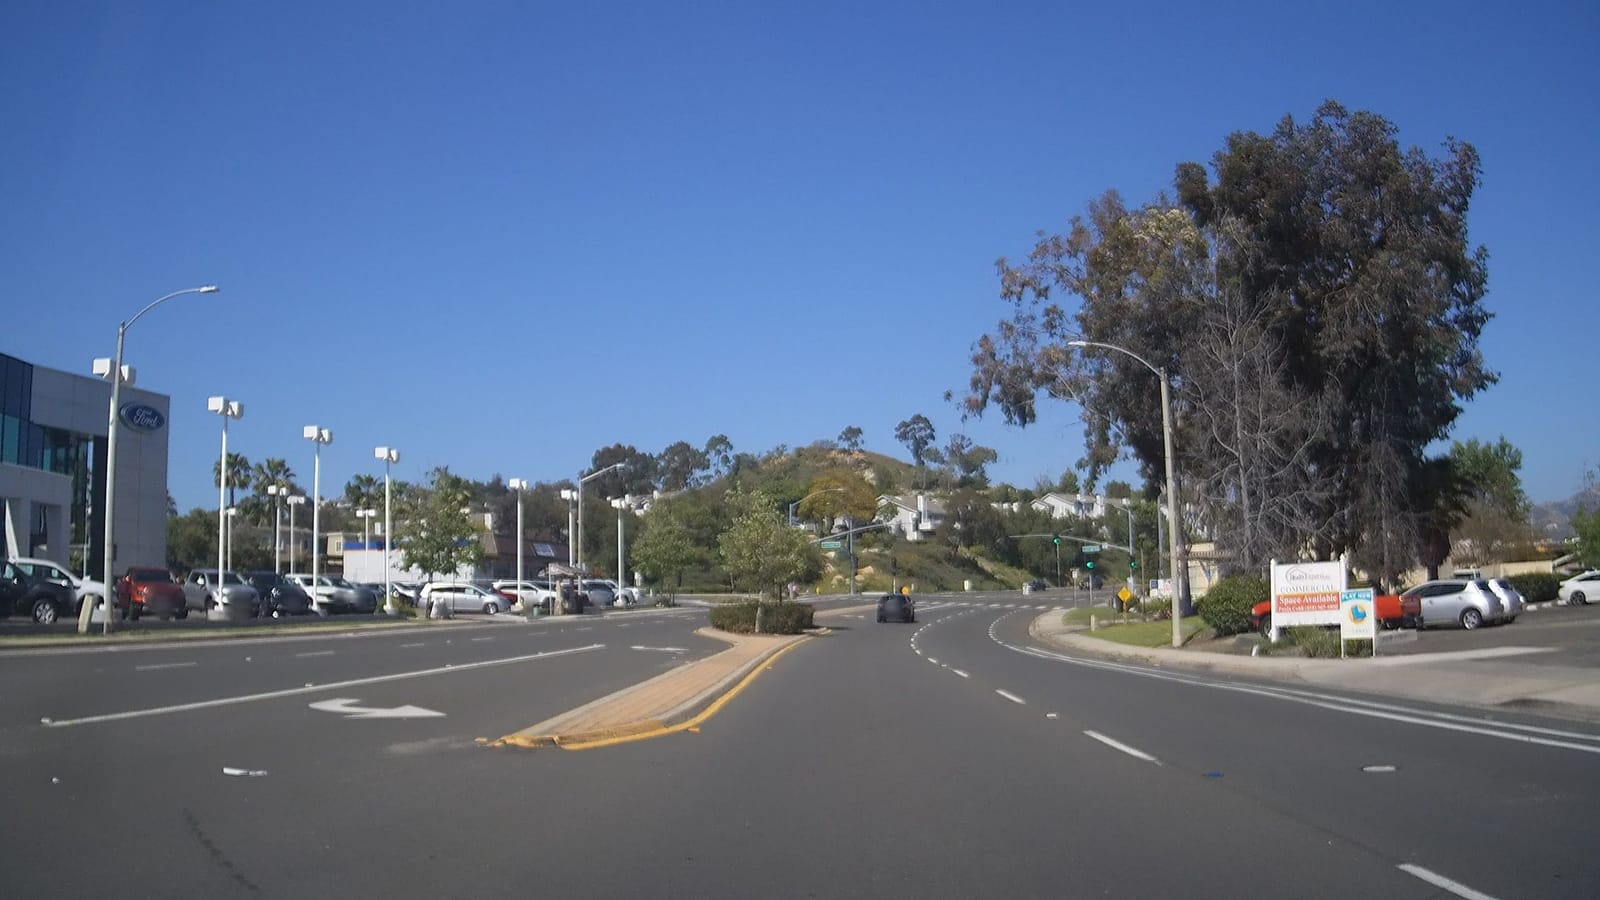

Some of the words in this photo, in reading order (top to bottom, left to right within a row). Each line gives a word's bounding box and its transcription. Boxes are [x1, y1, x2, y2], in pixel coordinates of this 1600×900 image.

[133, 408, 158, 425] Ford
[1280, 584, 1334, 593] COMMERCIAL
[1279, 595, 1301, 605] Space
[1303, 593, 1337, 603] Available
